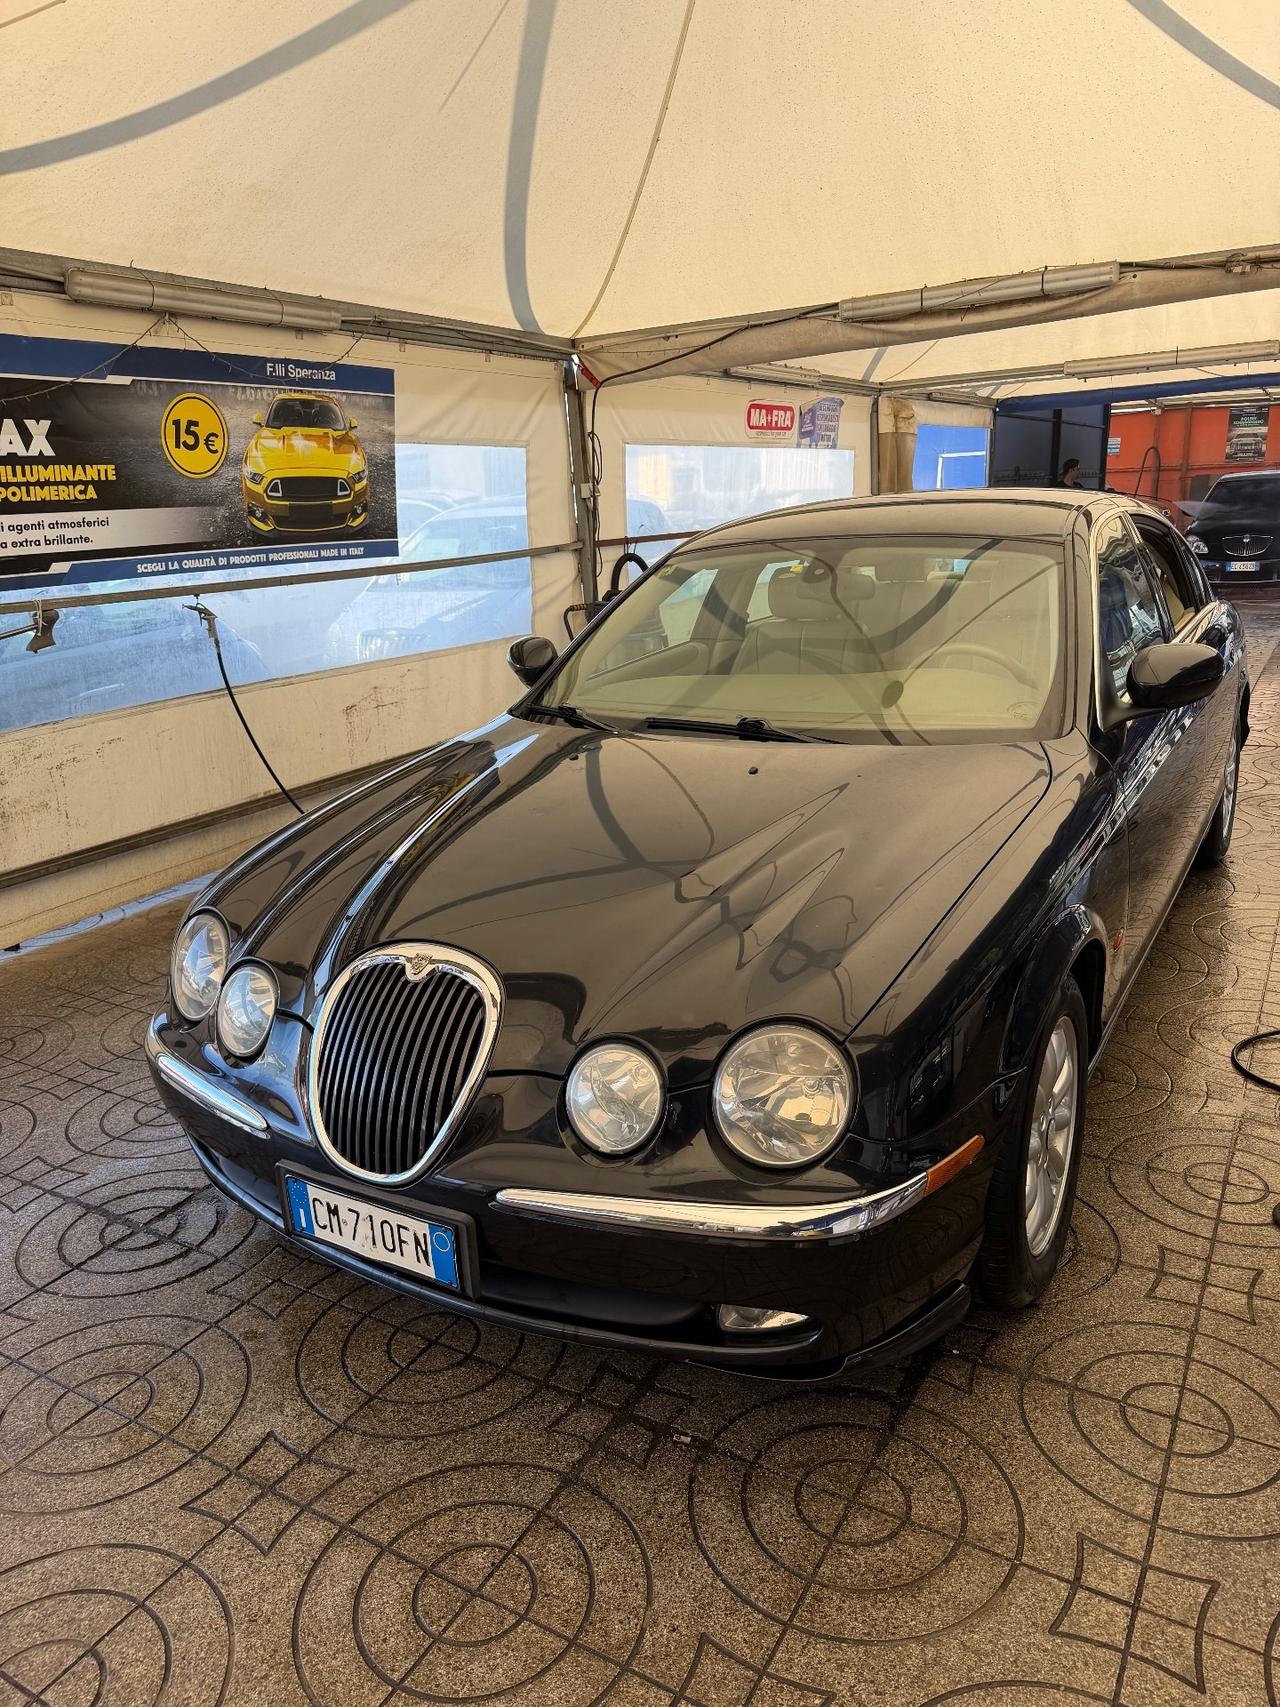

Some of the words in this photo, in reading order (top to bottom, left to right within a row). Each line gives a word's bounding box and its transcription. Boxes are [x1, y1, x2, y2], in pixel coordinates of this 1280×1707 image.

[266, 363, 285, 377] F.lli
[287, 364, 336, 382] Speranza
[0, 483, 98, 502] POLIMERICA
[7, 519, 45, 535] agenti
[47, 516, 110, 530] atmosferici
[11, 536, 42, 549] extra
[43, 533, 94, 547] brillante.
[137, 561, 166, 573] SCEGLI
[168, 559, 180, 570] LA
[182, 555, 216, 569] QUALITÀ
[218, 556, 227, 566] DI
[229, 553, 267, 565] PRODOTTI
[268, 549, 319, 562] PROFESSIONALI
[320, 548, 339, 558] MADE
[340, 547, 348, 557] IN
[349, 546, 365, 556] ITALY
